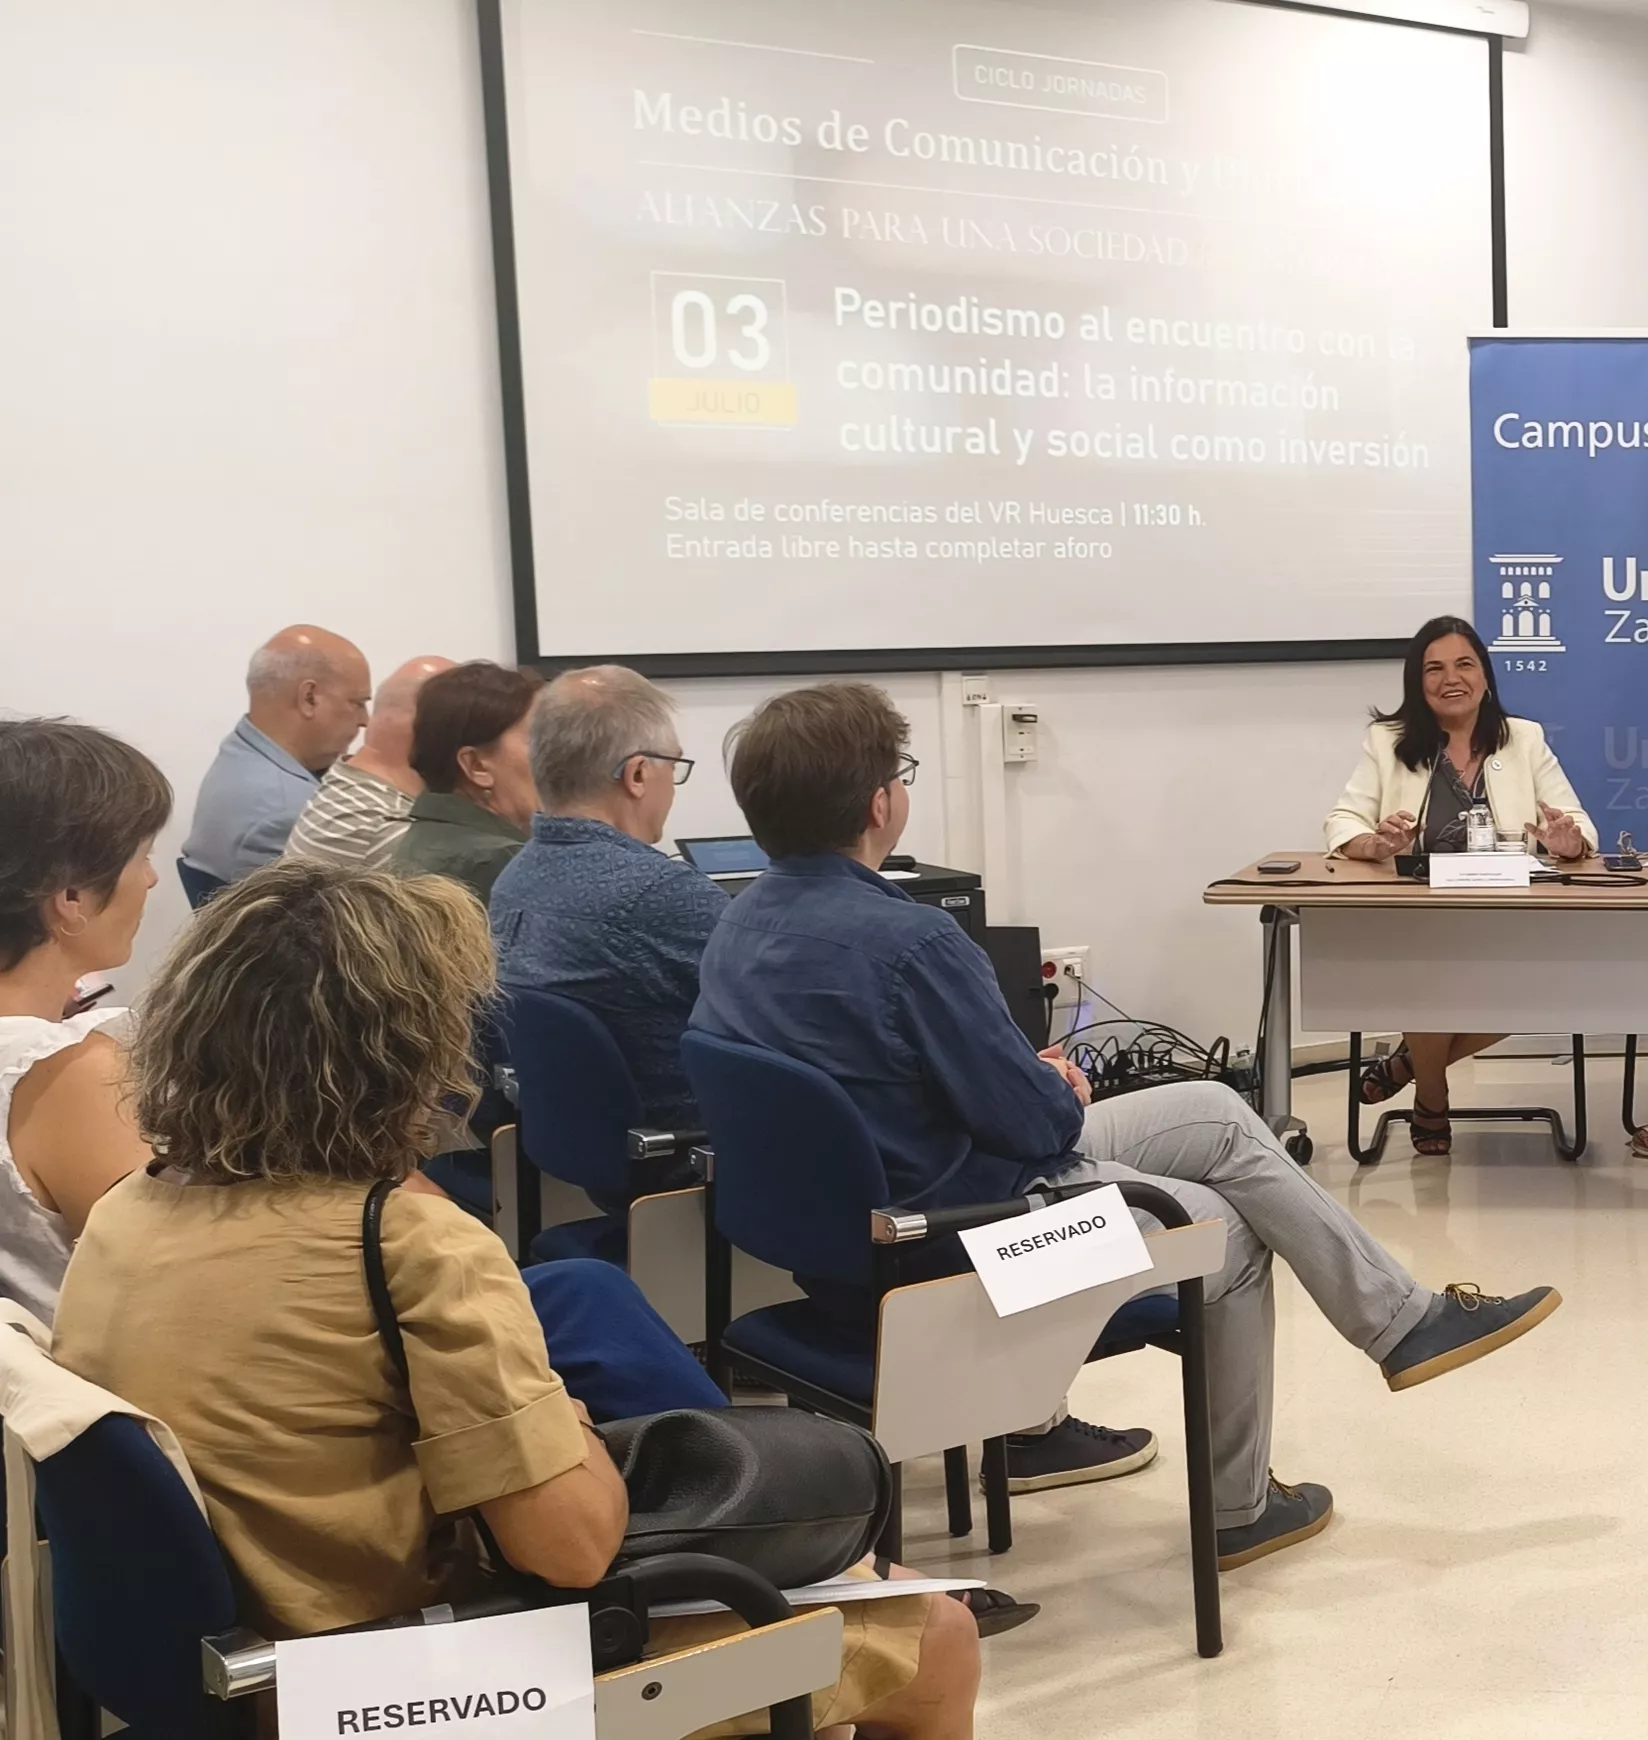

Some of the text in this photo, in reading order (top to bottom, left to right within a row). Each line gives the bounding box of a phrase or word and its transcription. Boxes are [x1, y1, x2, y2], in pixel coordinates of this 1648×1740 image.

[974, 64, 1148, 104] CICLO JORNADAS
[633, 89, 802, 146] Medios
[818, 110, 871, 155] de
[886, 117, 1169, 185] Comunicación
[1180, 160, 1201, 197] y
[637, 189, 828, 237] ALIANZAS
[842, 207, 929, 246] PARA
[942, 216, 1018, 253] UNA
[1027, 226, 1190, 267] SOCIEDAD
[671, 289, 771, 372] 03
[833, 287, 1066, 341] Periodismo
[1080, 306, 1114, 344] al
[1126, 314, 1305, 354] encuentro
[1319, 326, 1376, 360] con
[687, 390, 761, 415] JULIO
[837, 357, 1339, 411] comunidad: la información
[840, 414, 1430, 470] cultural y social como inversión
[664, 496, 726, 522] Sala
[733, 497, 766, 523] de
[774, 498, 938, 524] conferencias
[945, 499, 982, 525] del
[988, 502, 1022, 525] VR
[1029, 502, 1114, 526] Huesca
[1133, 503, 1181, 526] 11:30
[1188, 503, 1207, 527] h.
[666, 533, 1113, 564] Entrada libre hasta completar aforo
[1504, 659, 1548, 672] 1542
[997, 1215, 1107, 1261] RESERVADO
[337, 1687, 547, 1735] RESERVADO
